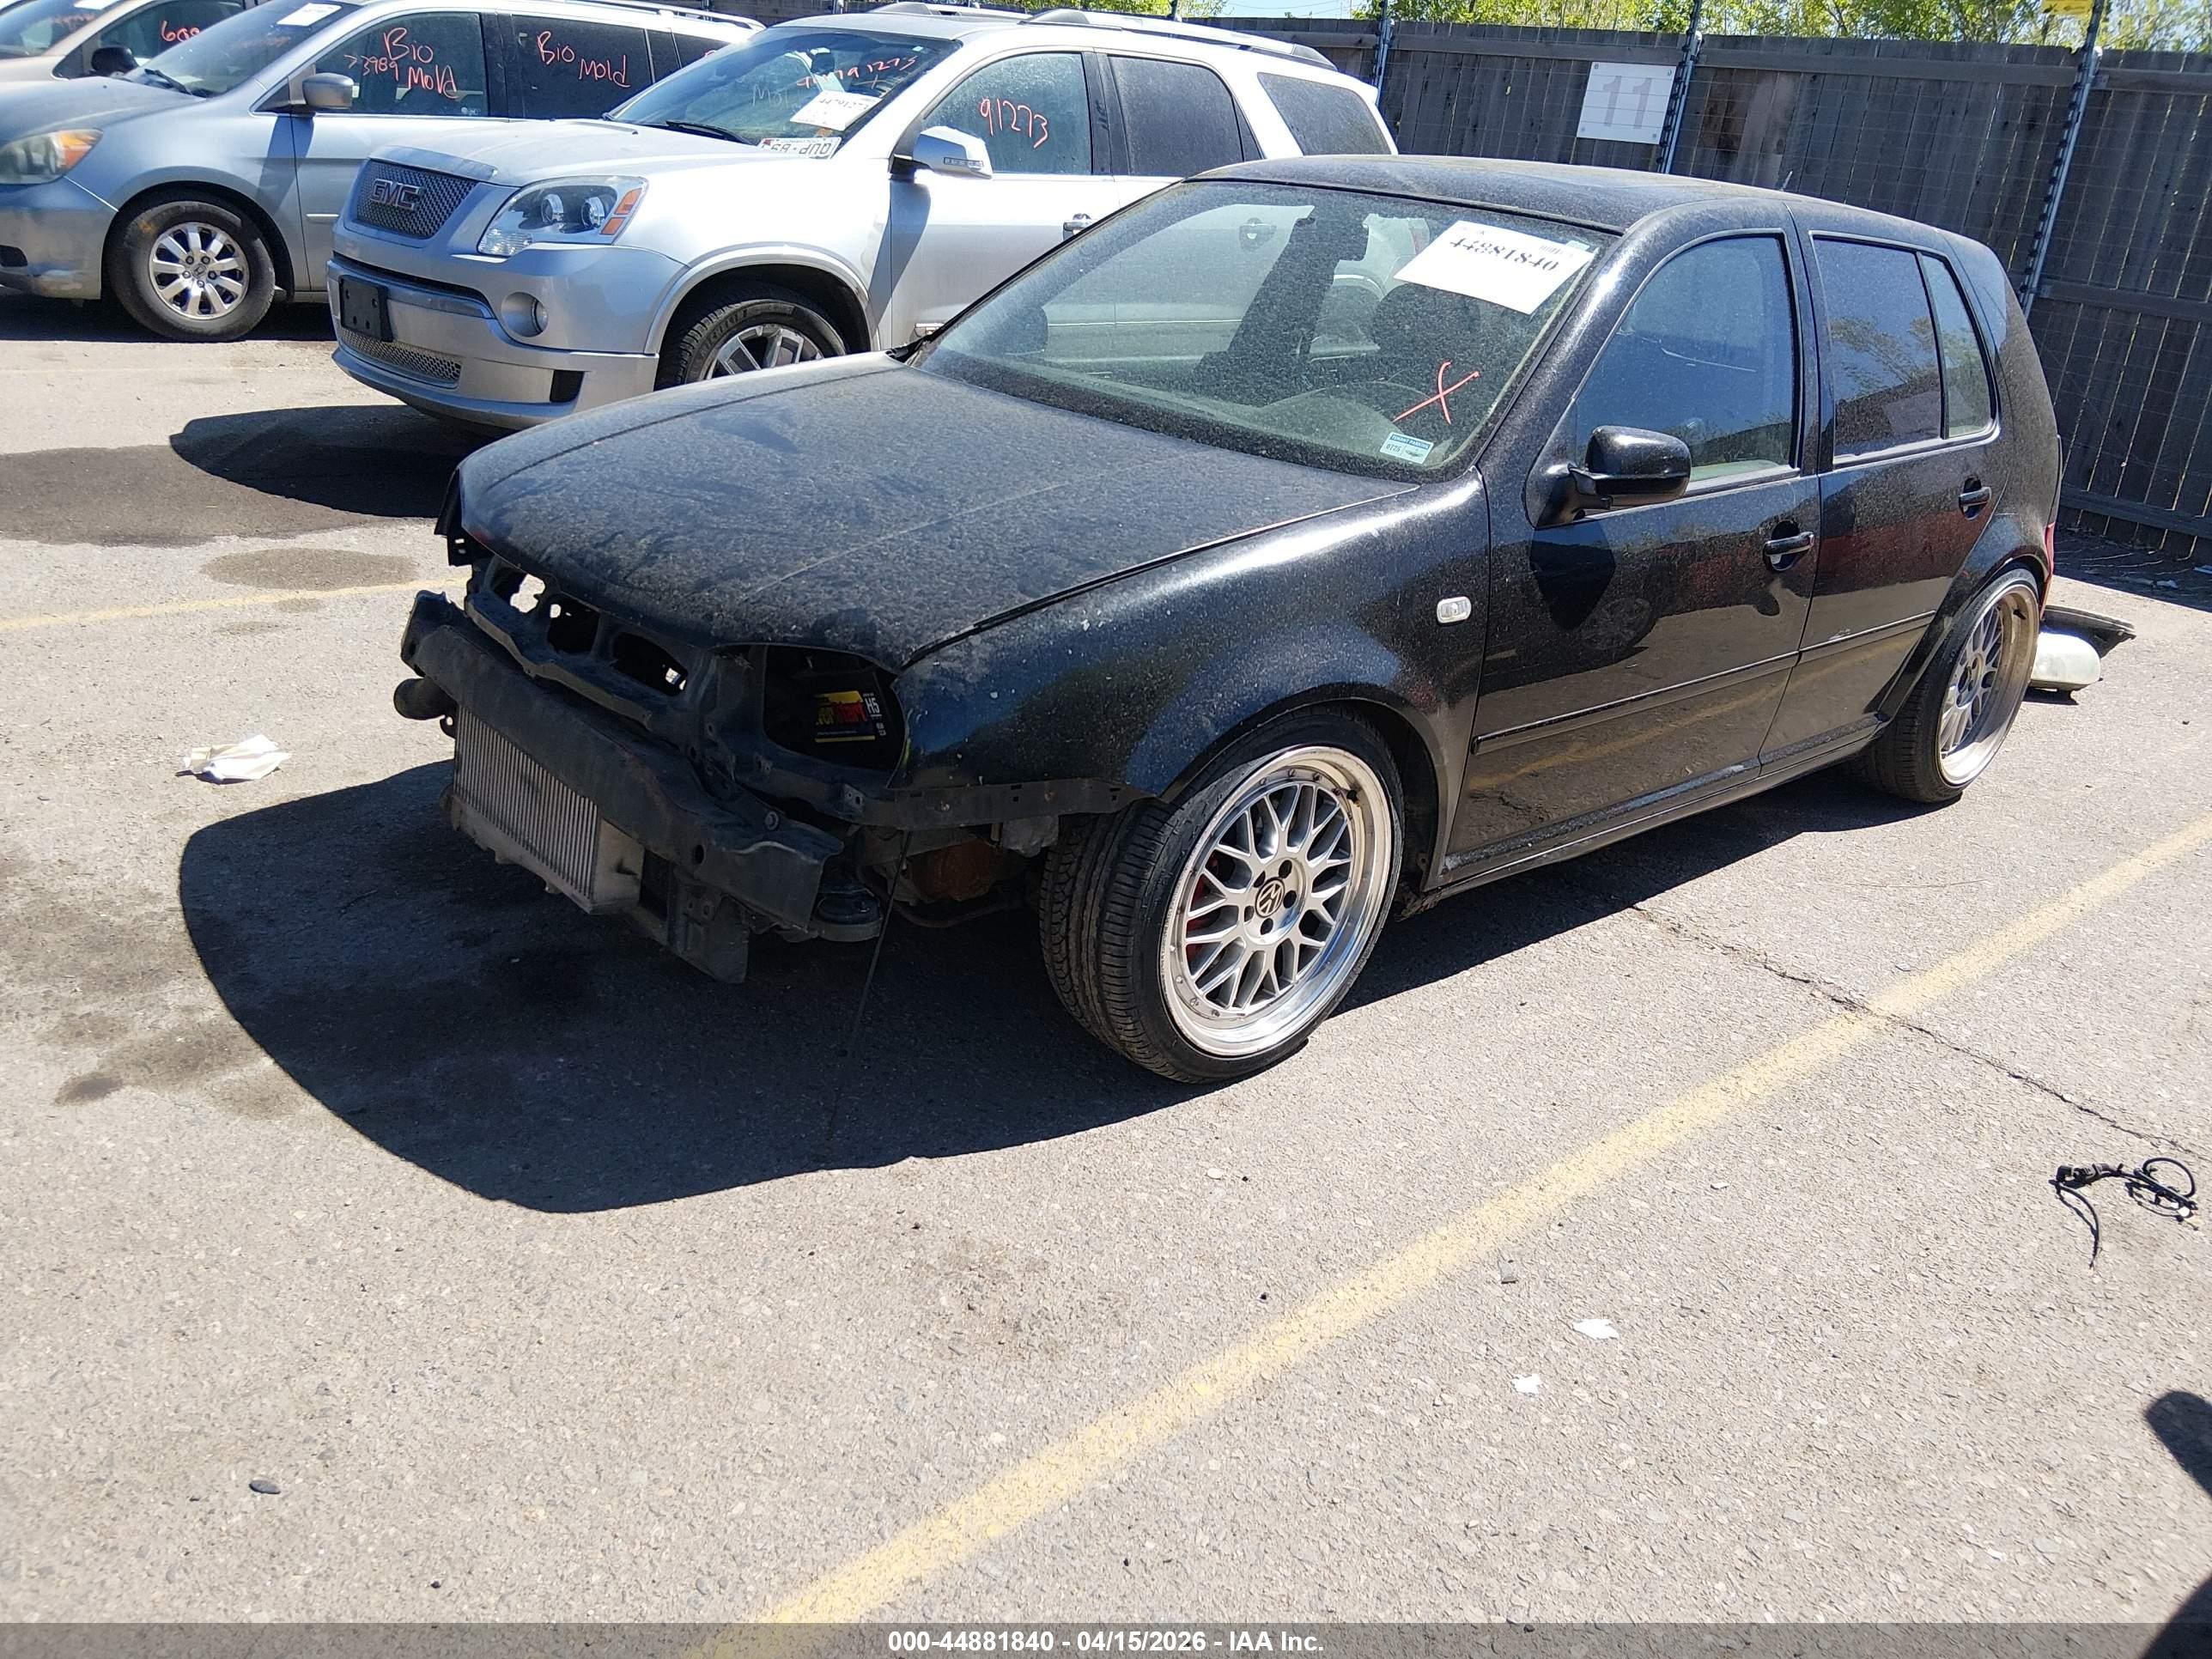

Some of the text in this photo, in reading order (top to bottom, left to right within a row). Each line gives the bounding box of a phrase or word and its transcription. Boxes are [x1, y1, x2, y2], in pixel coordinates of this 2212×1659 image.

[383, 27, 434, 64] Bio
[537, 31, 575, 65] Bio
[408, 64, 459, 99] Mold
[578, 54, 631, 88] Mold
[1602, 76, 1652, 129] 11
[980, 99, 1048, 149] 91273
[370, 178, 419, 210] GMC
[864, 697, 880, 714] H5
